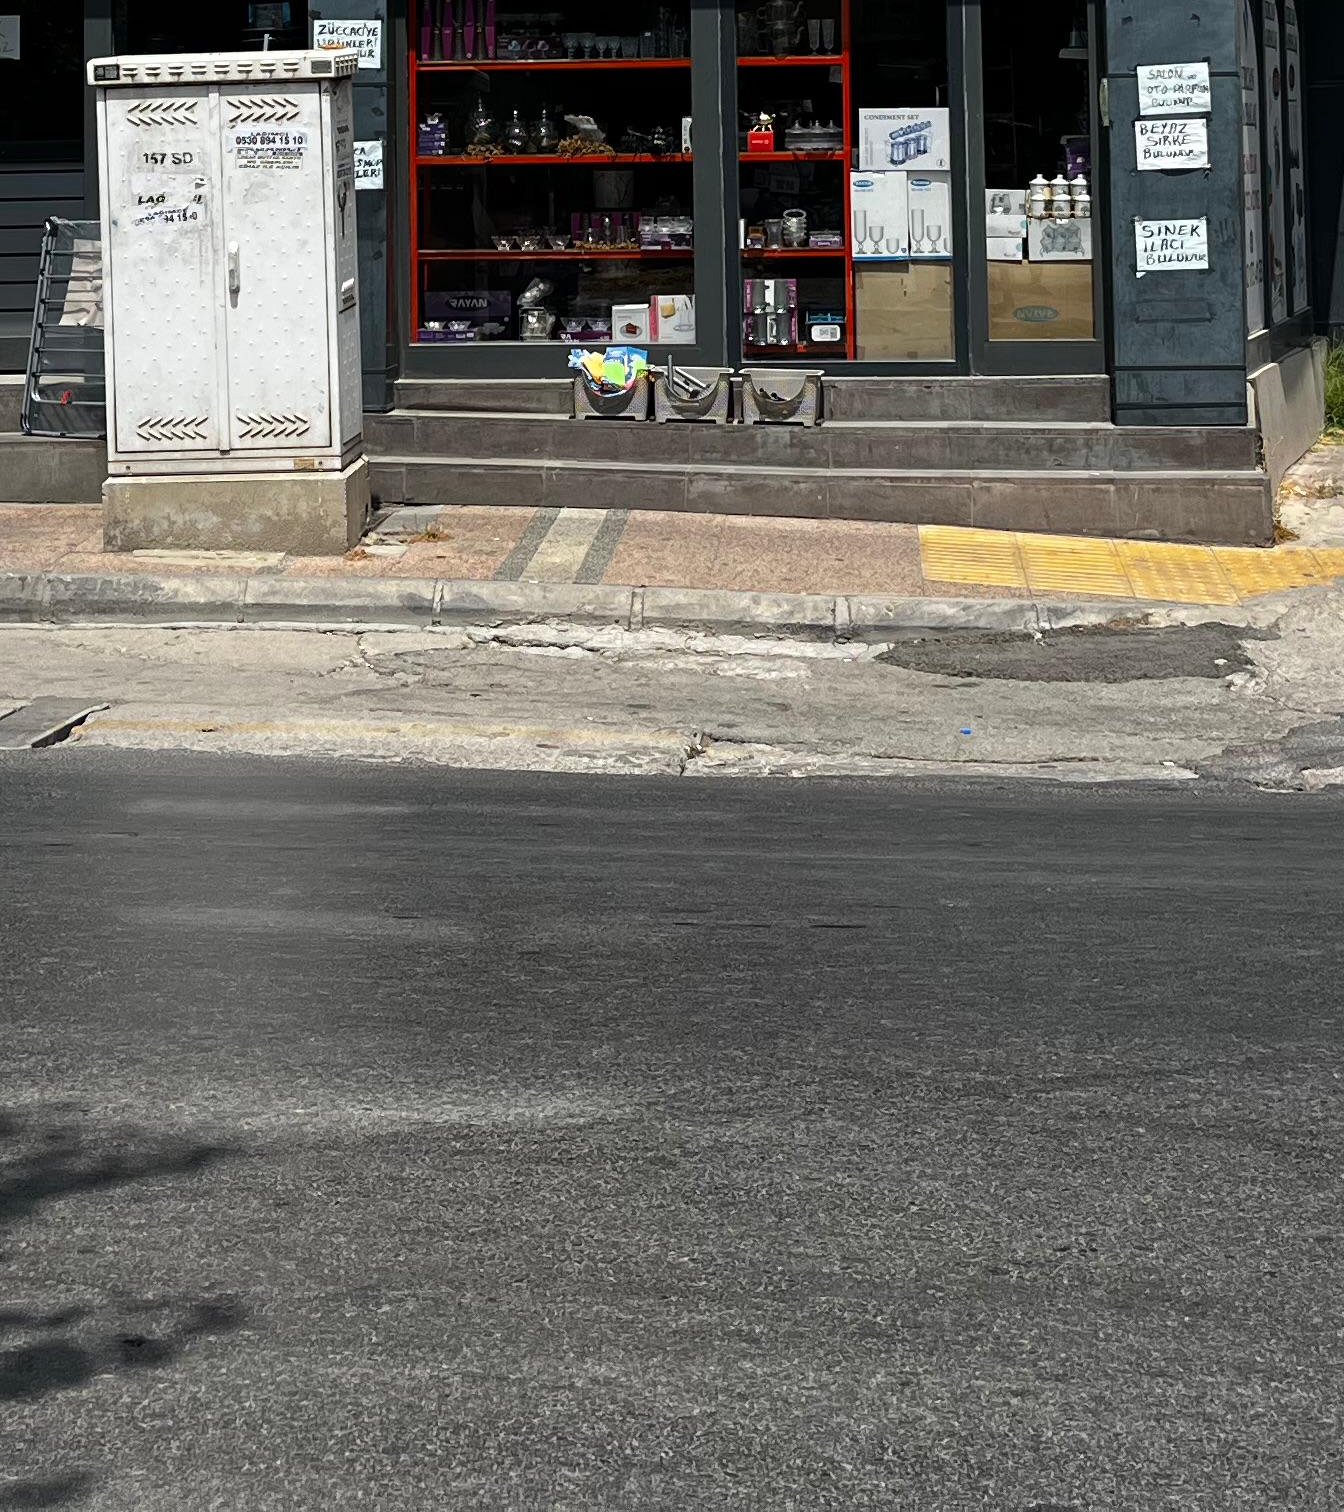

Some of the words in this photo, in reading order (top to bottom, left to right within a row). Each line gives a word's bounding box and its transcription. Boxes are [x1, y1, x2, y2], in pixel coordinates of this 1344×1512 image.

[1140, 122, 1188, 135] BEYAZ
[236, 136, 258, 145] 0530
[279, 136, 290, 145] 15
[293, 136, 303, 145] 10
[171, 152, 193, 165] SD
[449, 298, 488, 308] RAYAN
